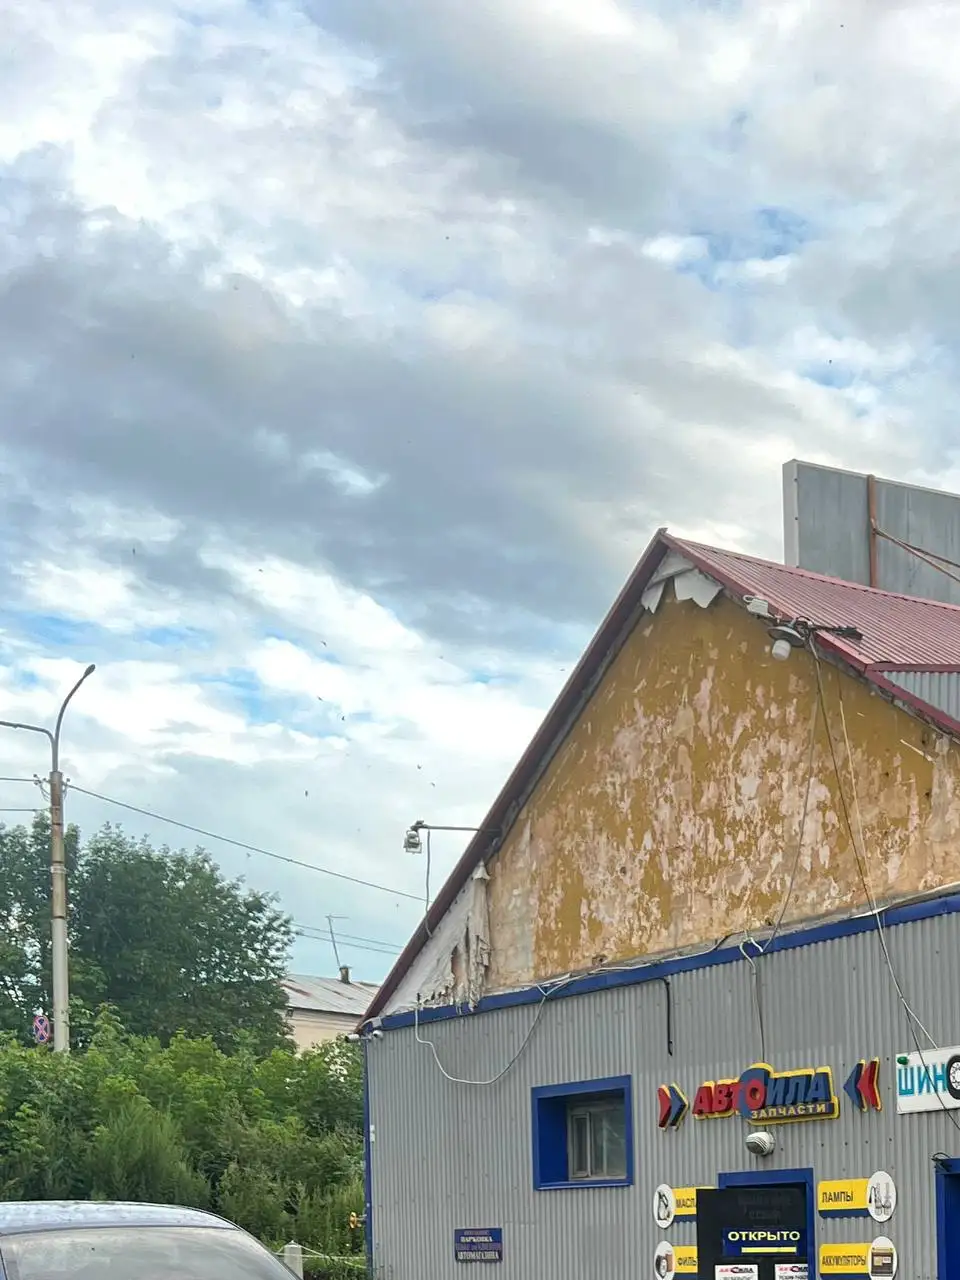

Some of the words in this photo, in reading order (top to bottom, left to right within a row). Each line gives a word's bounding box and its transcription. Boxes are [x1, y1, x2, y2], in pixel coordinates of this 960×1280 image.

[751, 1103, 826, 1119] ЗАПЧАСТИ
[822, 1191, 853, 1203] ЛАМПЫ
[728, 1231, 800, 1241] ОТКРЫТО
[822, 1255, 866, 1266] АККУМУЛЯТОРЫ
